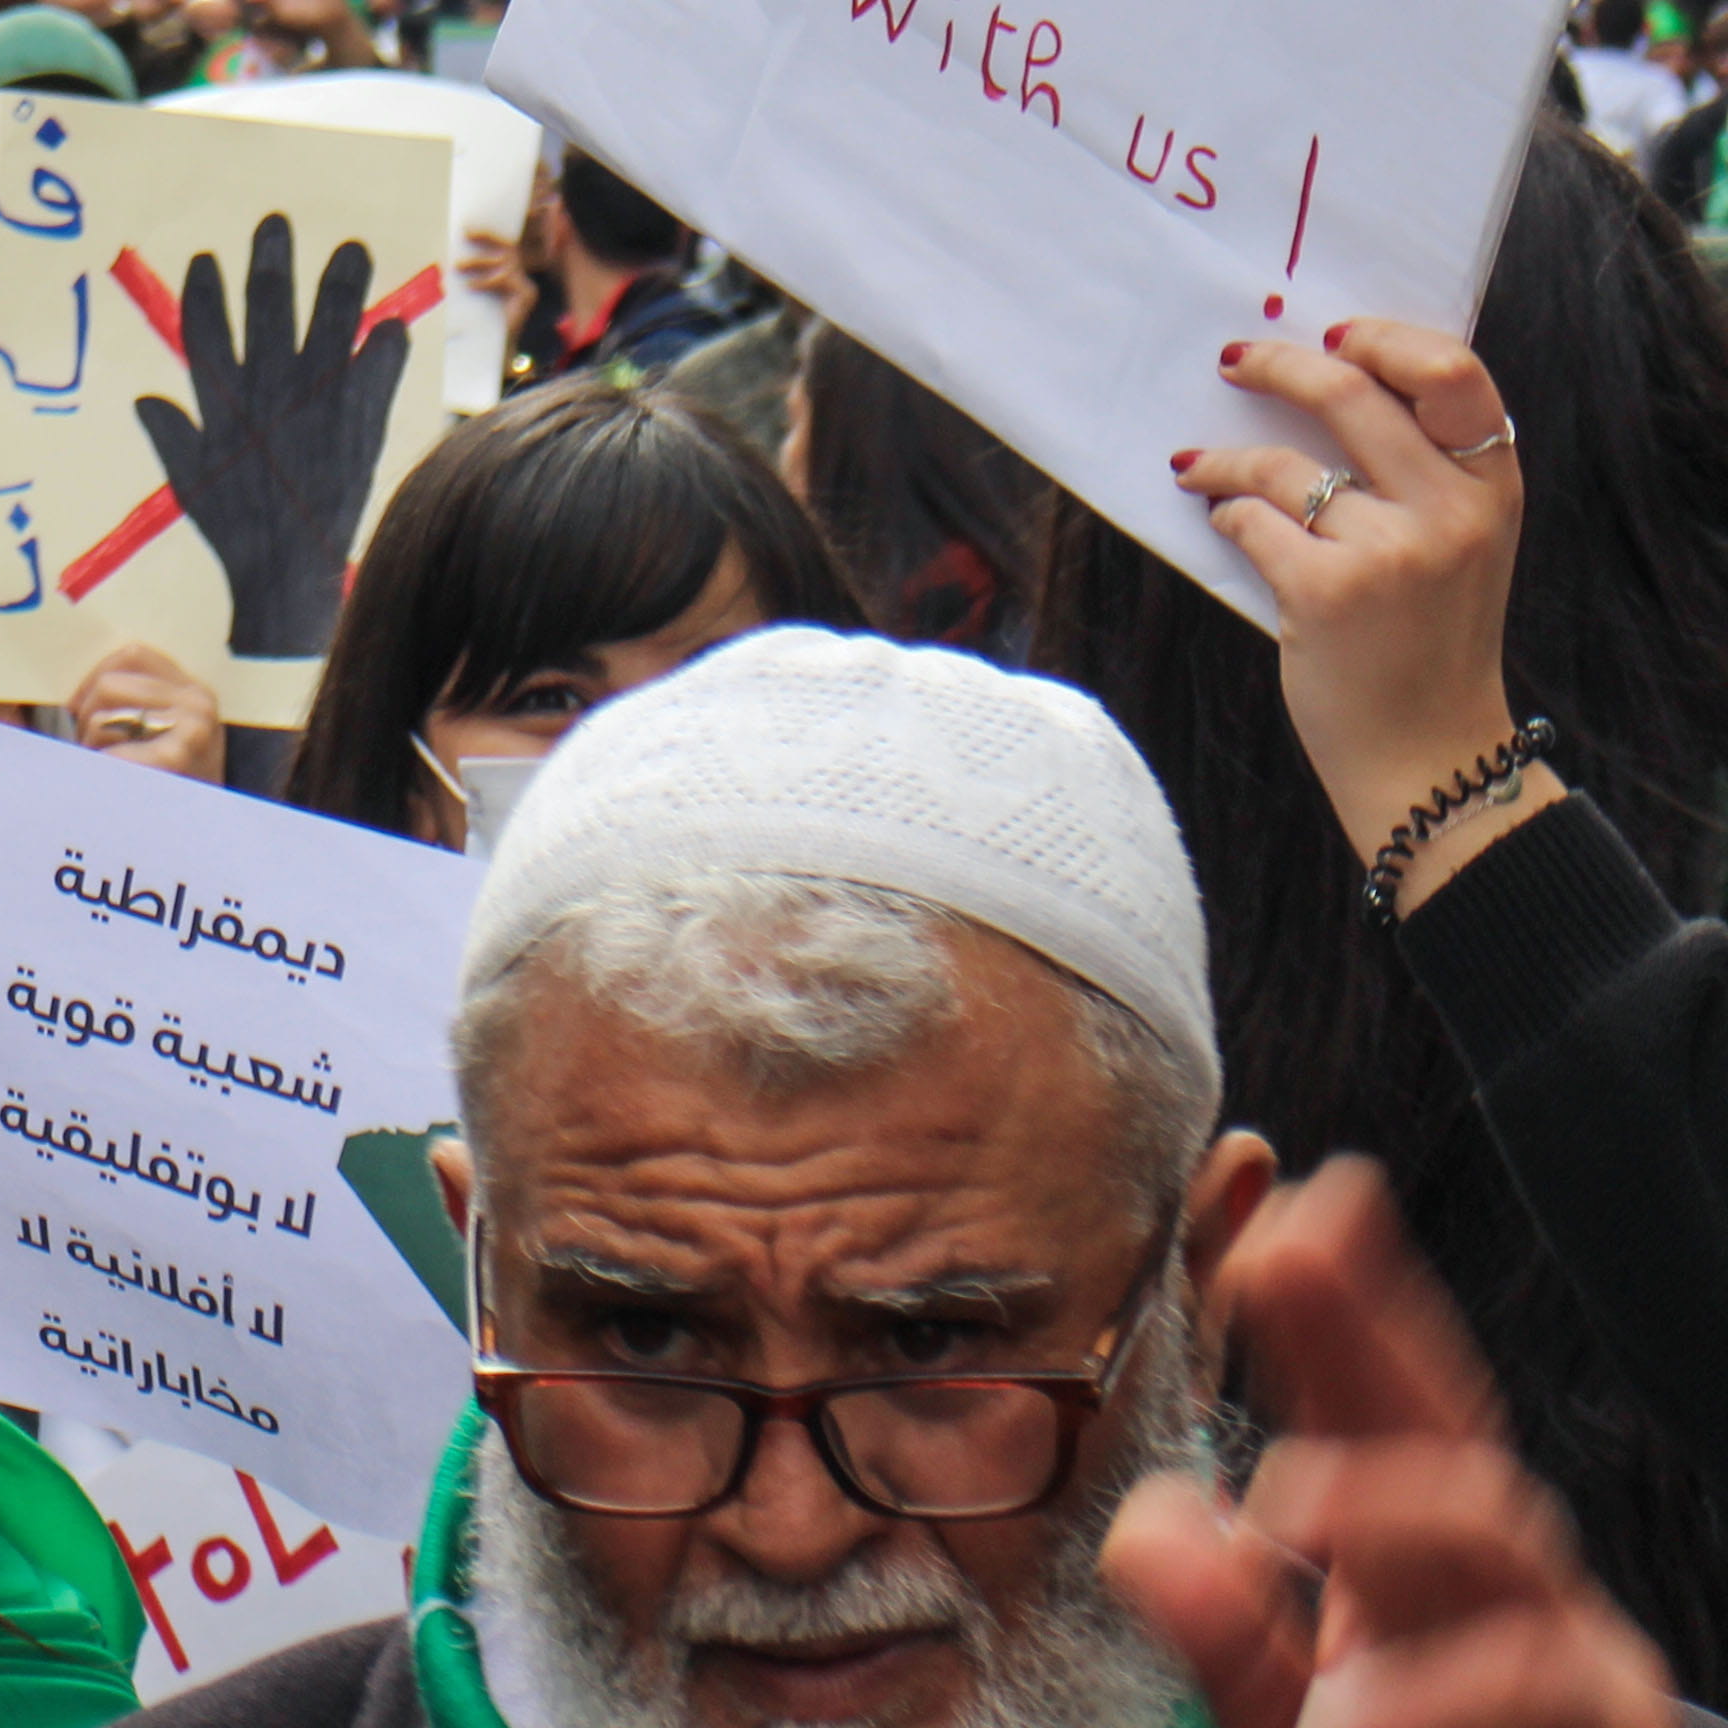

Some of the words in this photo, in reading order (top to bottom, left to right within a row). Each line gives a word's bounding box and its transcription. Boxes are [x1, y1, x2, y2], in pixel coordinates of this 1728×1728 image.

[54, 848, 345, 984] ديمقراطية
[6, 965, 136, 1047] قوية
[152, 1012, 342, 1116] شعبية
[0, 1087, 261, 1234] بوتفليقية
[17, 1215, 51, 1254] لا
[275, 1192, 316, 1239] لا
[66, 1227, 236, 1327] أفلانية
[249, 1304, 284, 1347] لا
